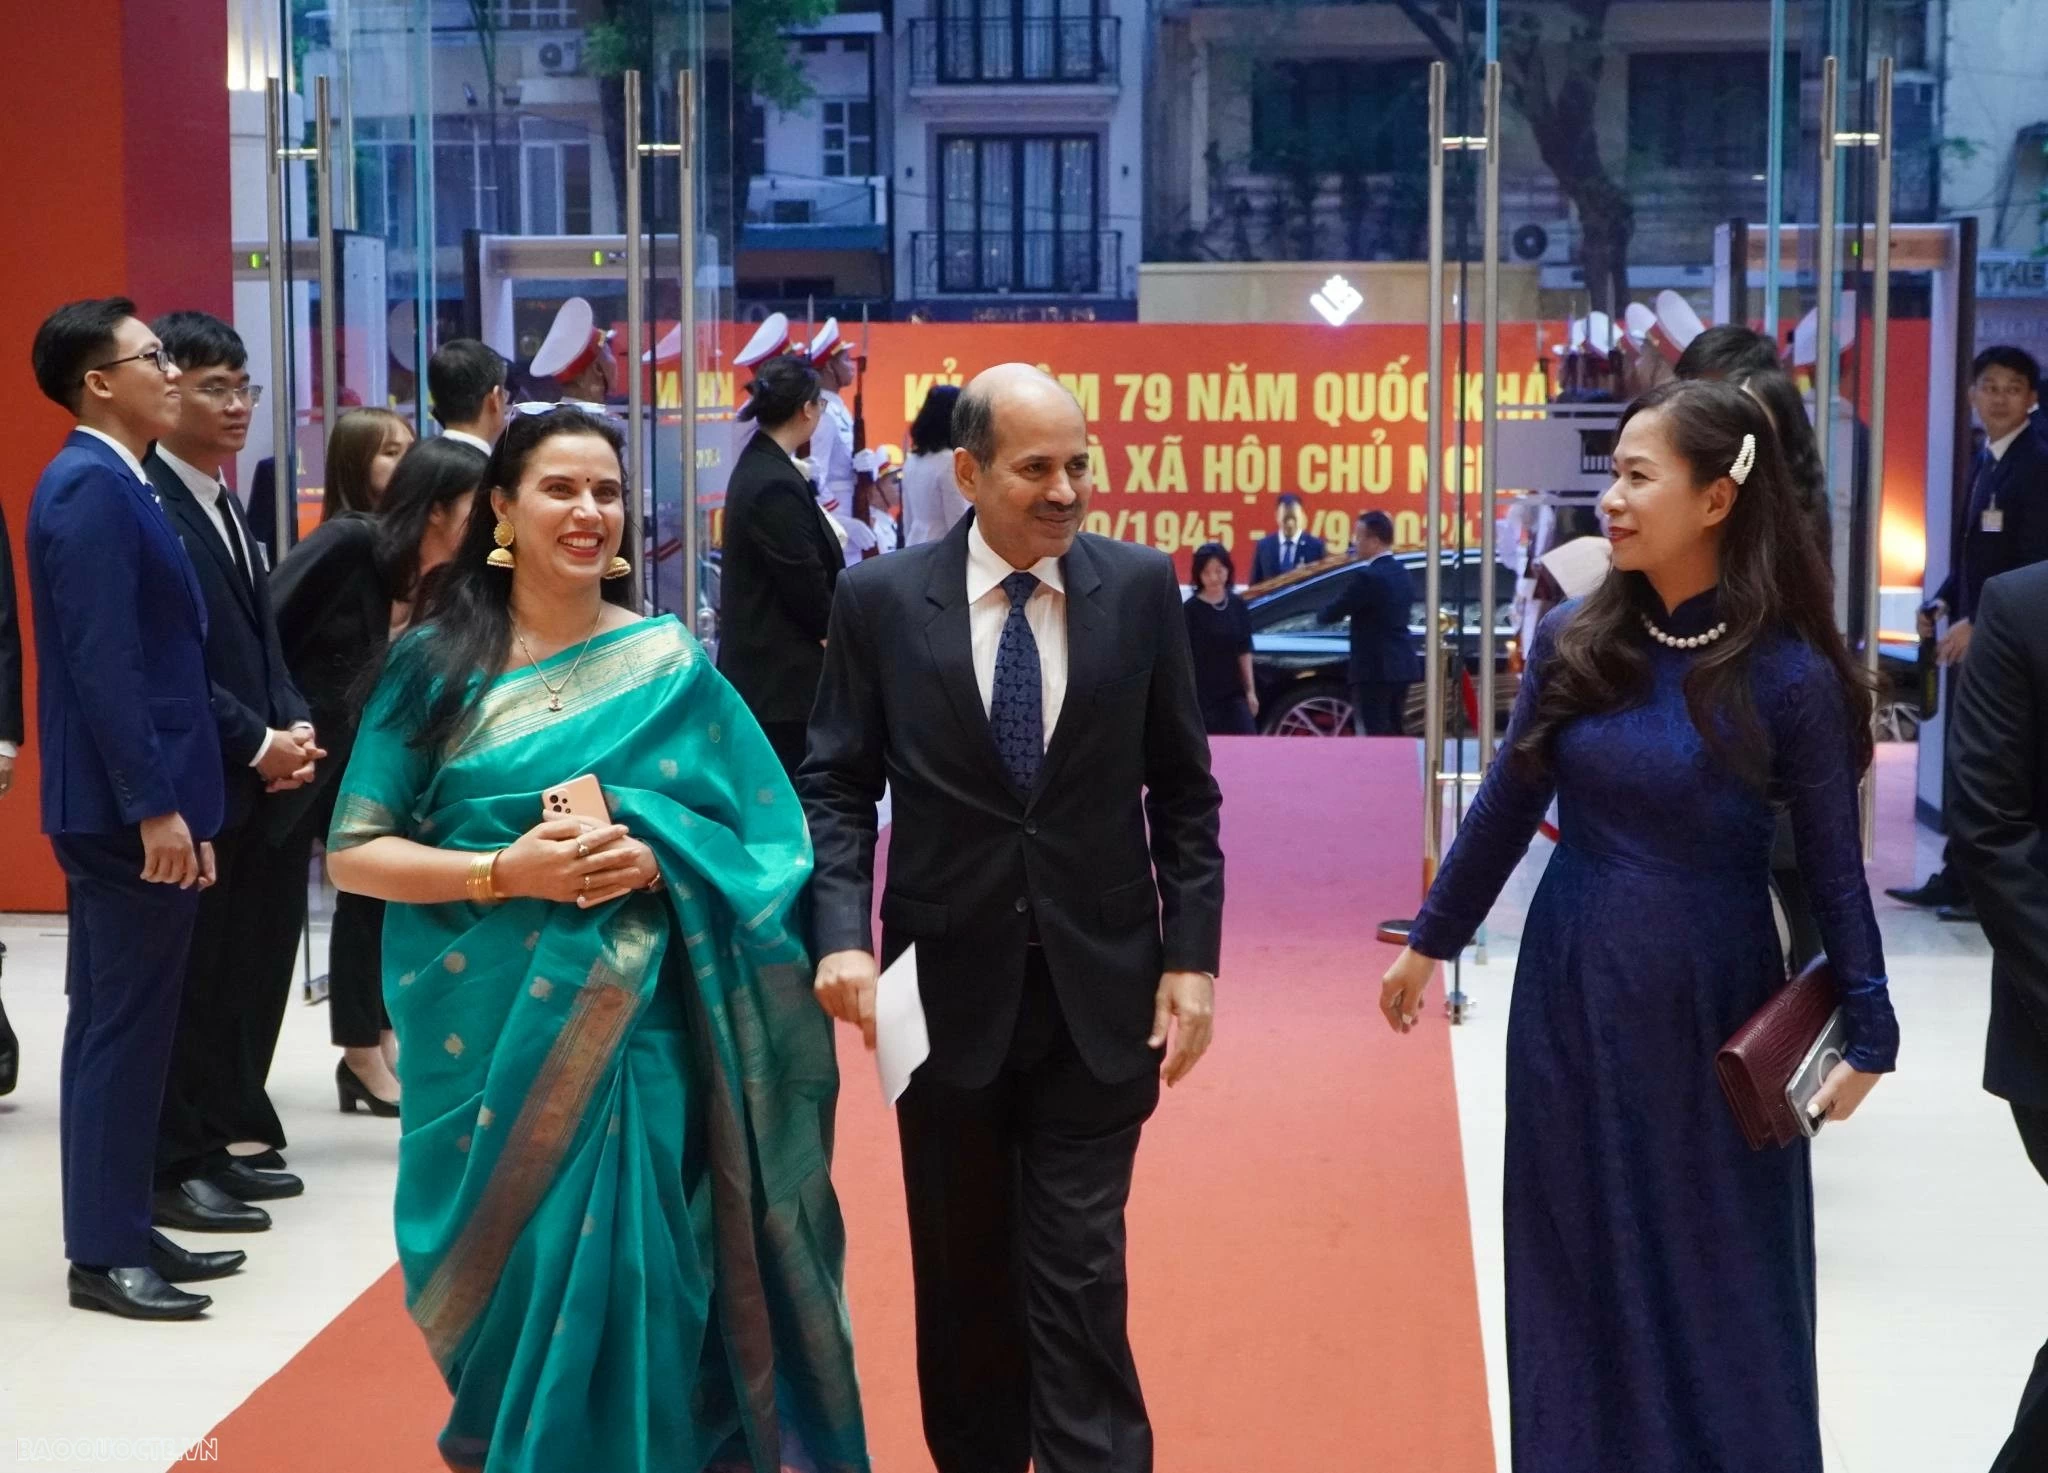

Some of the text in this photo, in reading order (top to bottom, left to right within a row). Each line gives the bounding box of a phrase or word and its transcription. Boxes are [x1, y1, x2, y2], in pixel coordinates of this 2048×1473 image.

[1114, 373, 1172, 422] 79
[1187, 362, 1297, 422] NĂM
[1313, 354, 1429, 427] QUỐC
[1124, 435, 1188, 493] XÃ
[1203, 434, 1281, 504] HỘI
[1298, 428, 1393, 494] CHỦ
